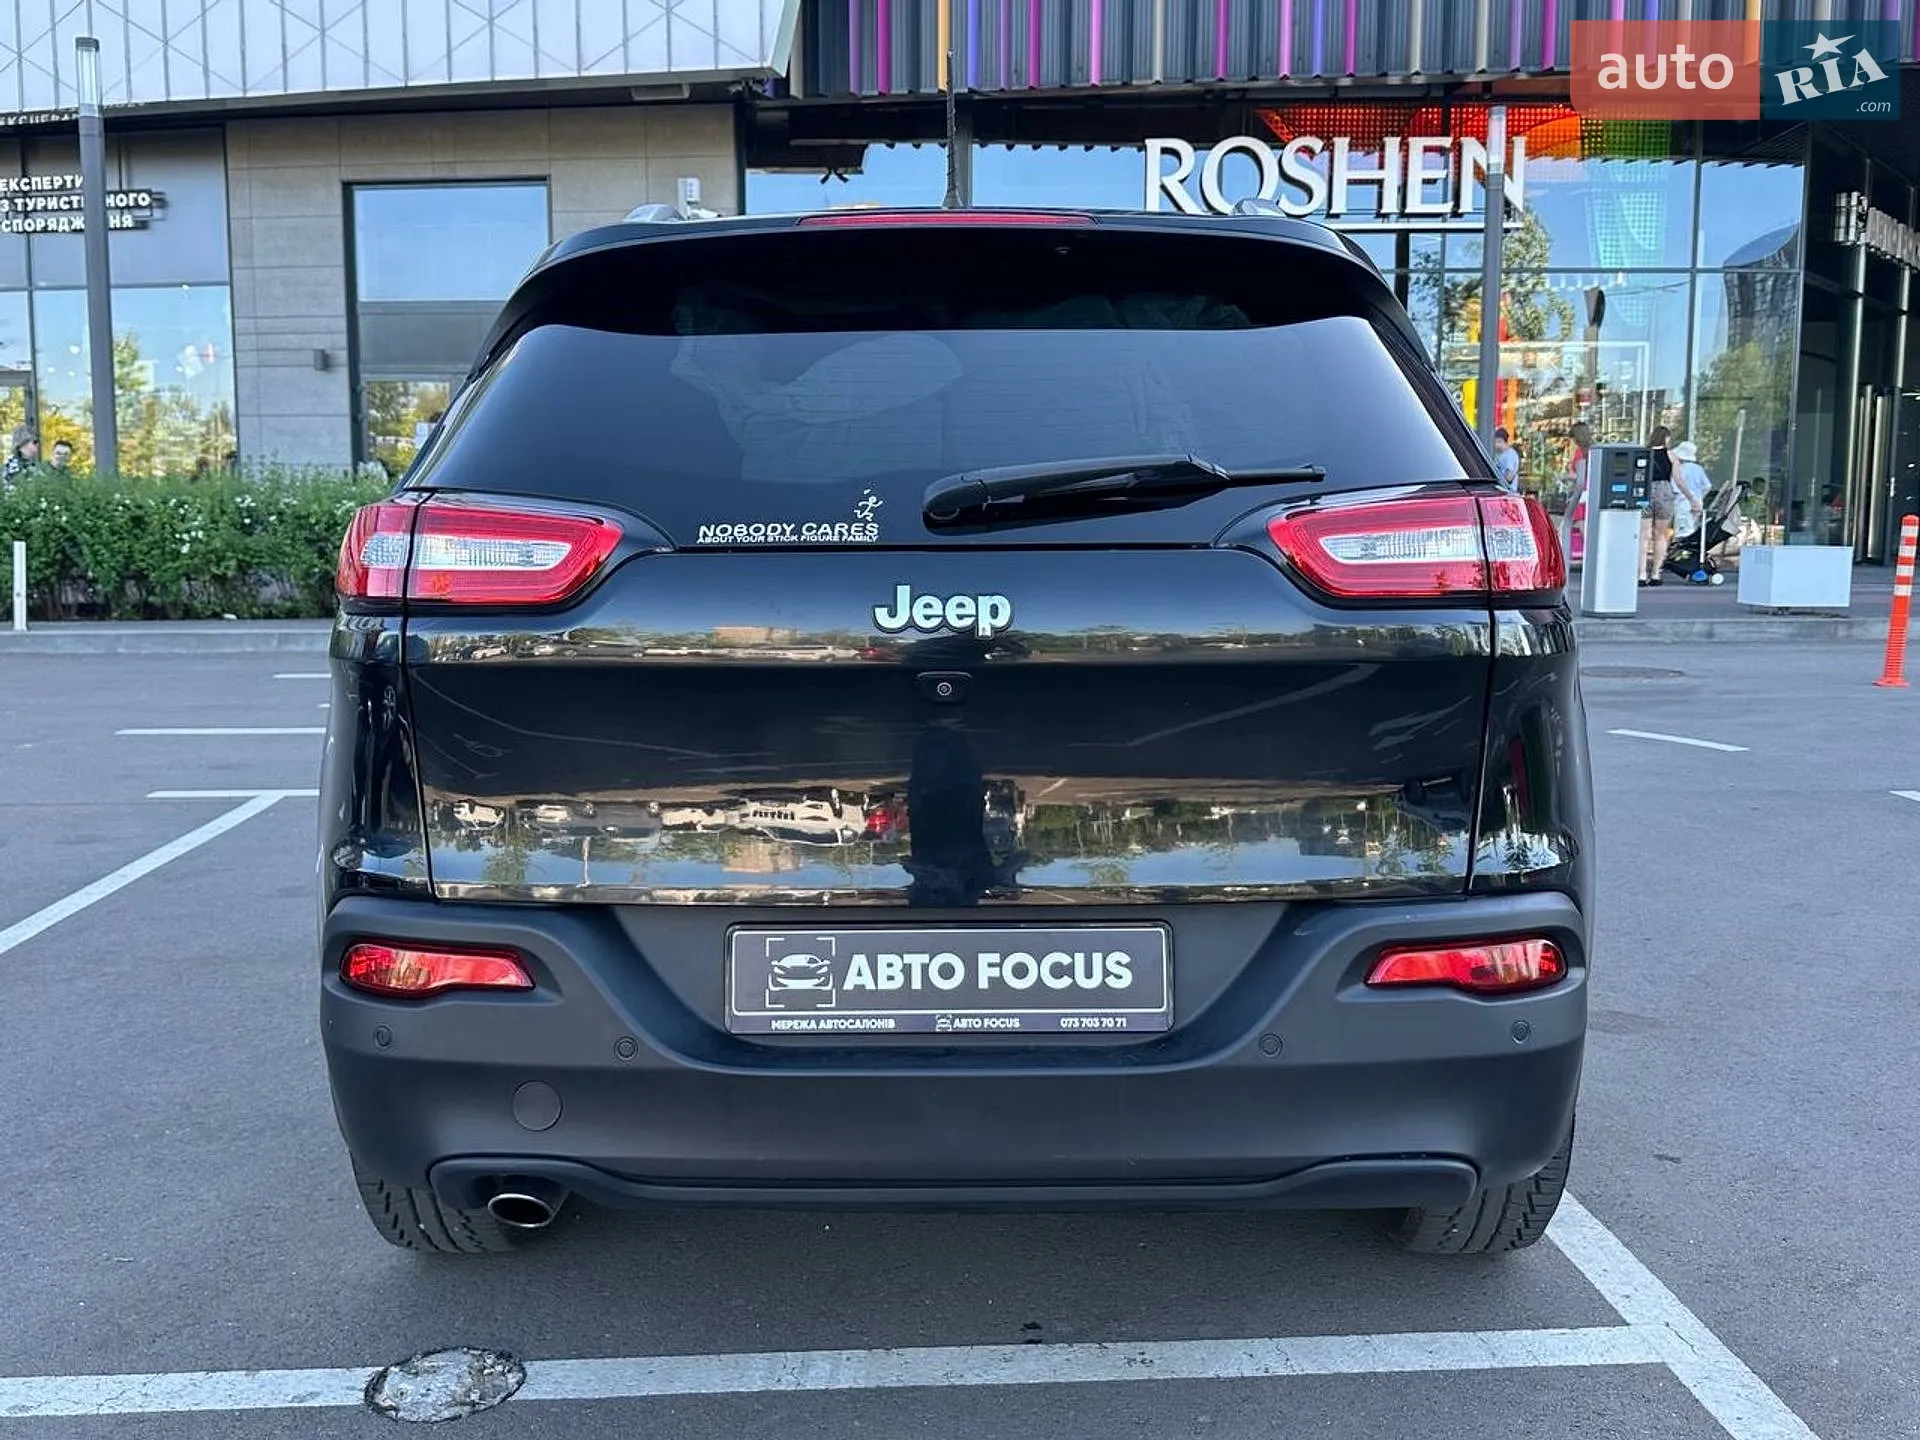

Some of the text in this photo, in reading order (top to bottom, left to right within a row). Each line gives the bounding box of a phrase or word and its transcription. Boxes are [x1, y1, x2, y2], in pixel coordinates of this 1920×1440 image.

[1144, 135, 1525, 216] ROSHEN
[14, 192, 151, 211] ТУРИСТНОГО
[1, 214, 133, 232] СПОРЯДЖНЯ
[699, 522, 879, 537] NOBODY CARES
[696, 535, 734, 544] ABOUT
[736, 535, 765, 543] YOUR
[874, 584, 1011, 637] Jeep
[843, 951, 1133, 990] АВТО FOCUS
[771, 1018, 896, 1030] МЕРЕЖА АВТОСАЛОНІВ
[953, 1017, 1020, 1028] АВТО FOCUS
[1060, 1017, 1127, 1028] 073 703 70 71
